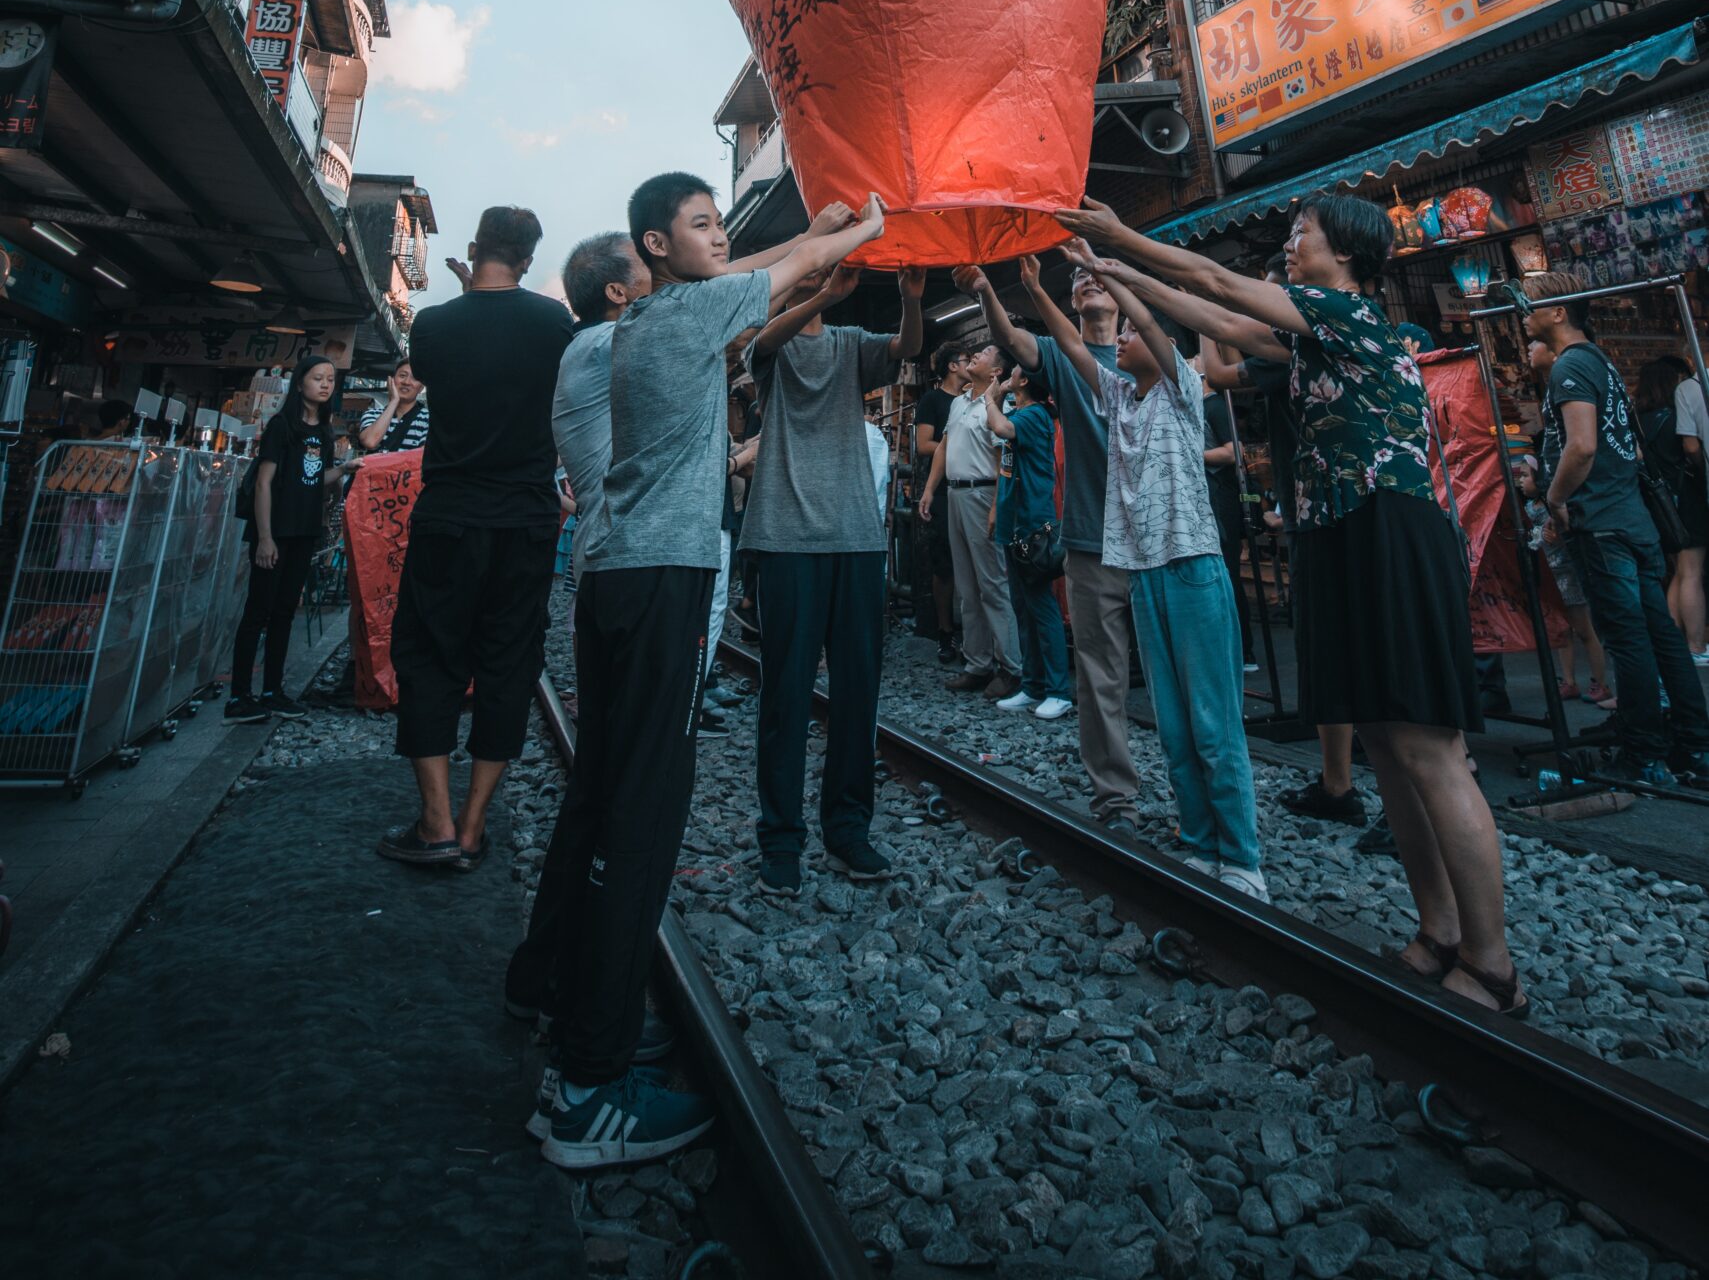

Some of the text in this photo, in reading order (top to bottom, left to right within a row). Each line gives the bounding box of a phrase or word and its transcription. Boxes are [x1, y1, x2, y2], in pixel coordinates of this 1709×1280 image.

[1211, 58, 1304, 112] Hu's skylantern
[1548, 132, 1601, 199] 天燈
[1556, 191, 1602, 214] 150
